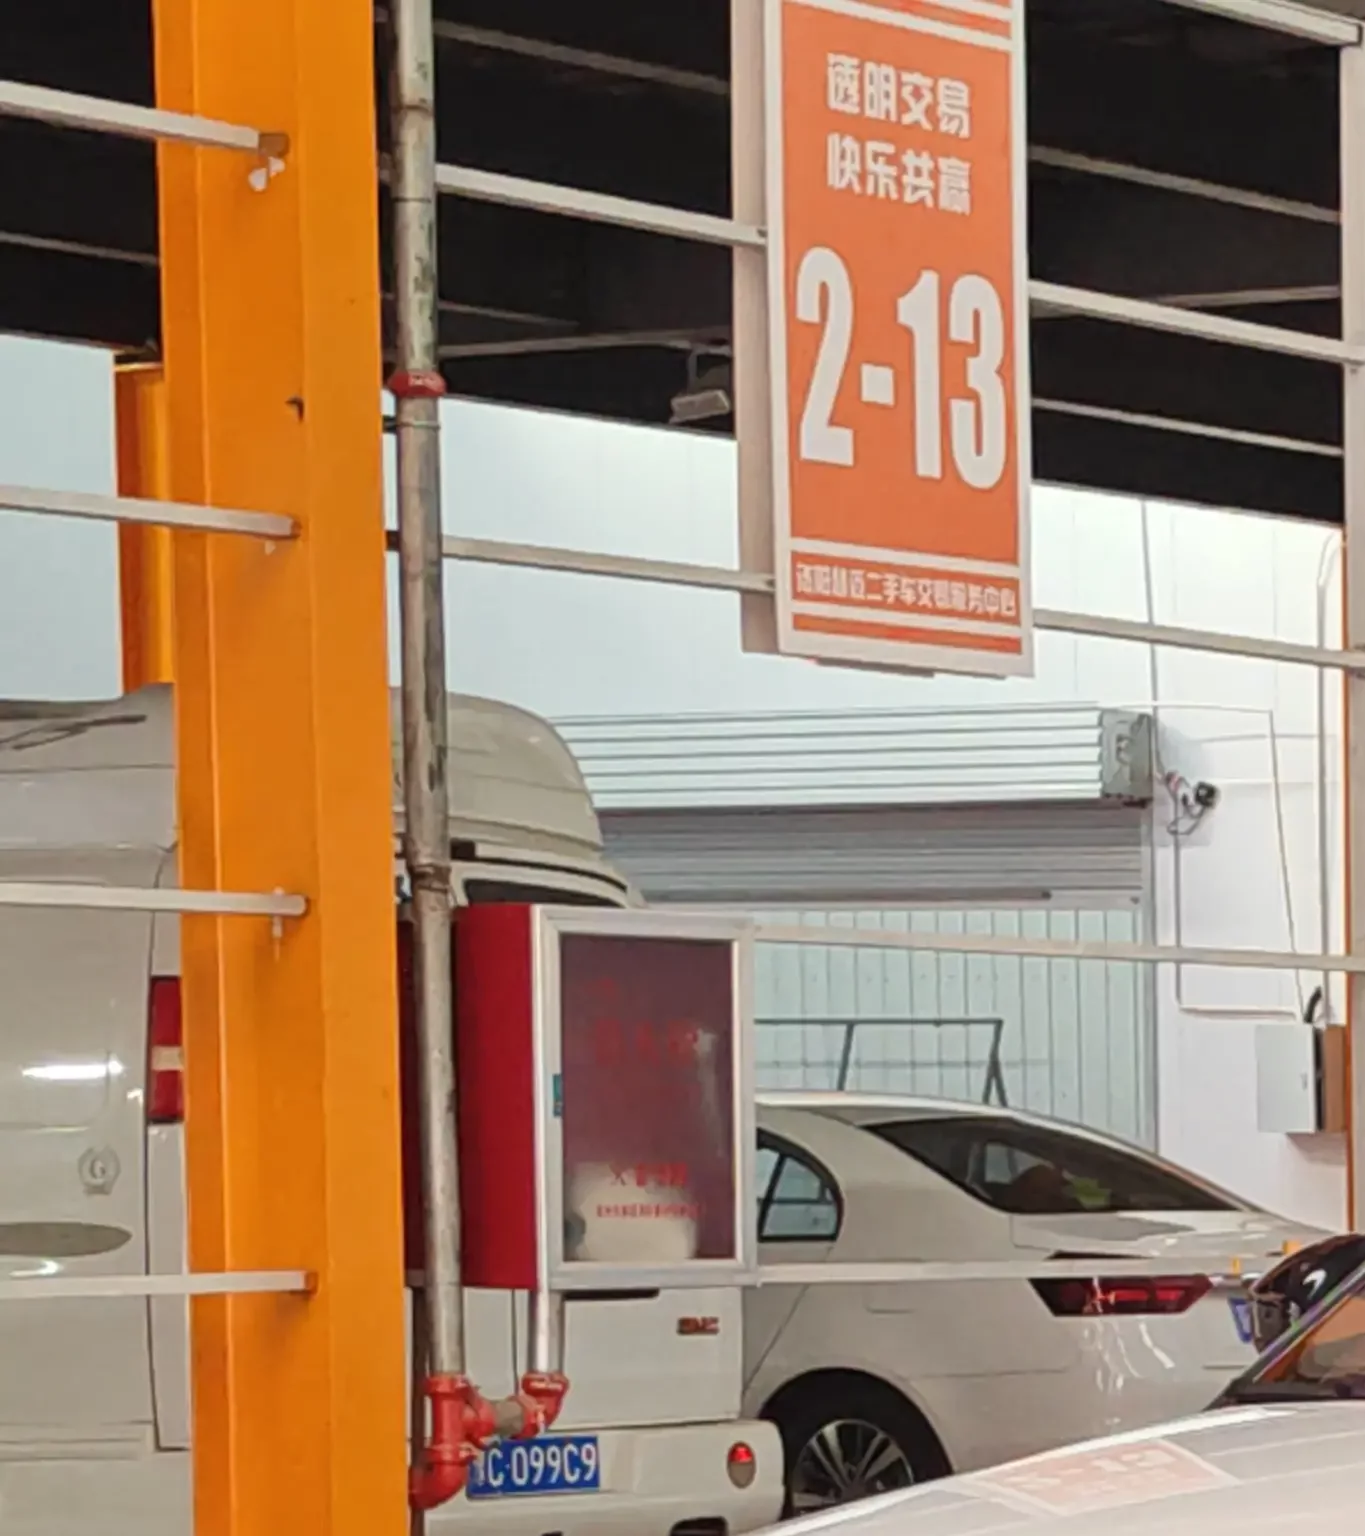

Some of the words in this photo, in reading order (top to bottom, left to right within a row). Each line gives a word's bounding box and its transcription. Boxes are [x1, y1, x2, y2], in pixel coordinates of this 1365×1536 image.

[826, 52, 970, 139] 透明交易
[795, 246, 1007, 489] 2-13
